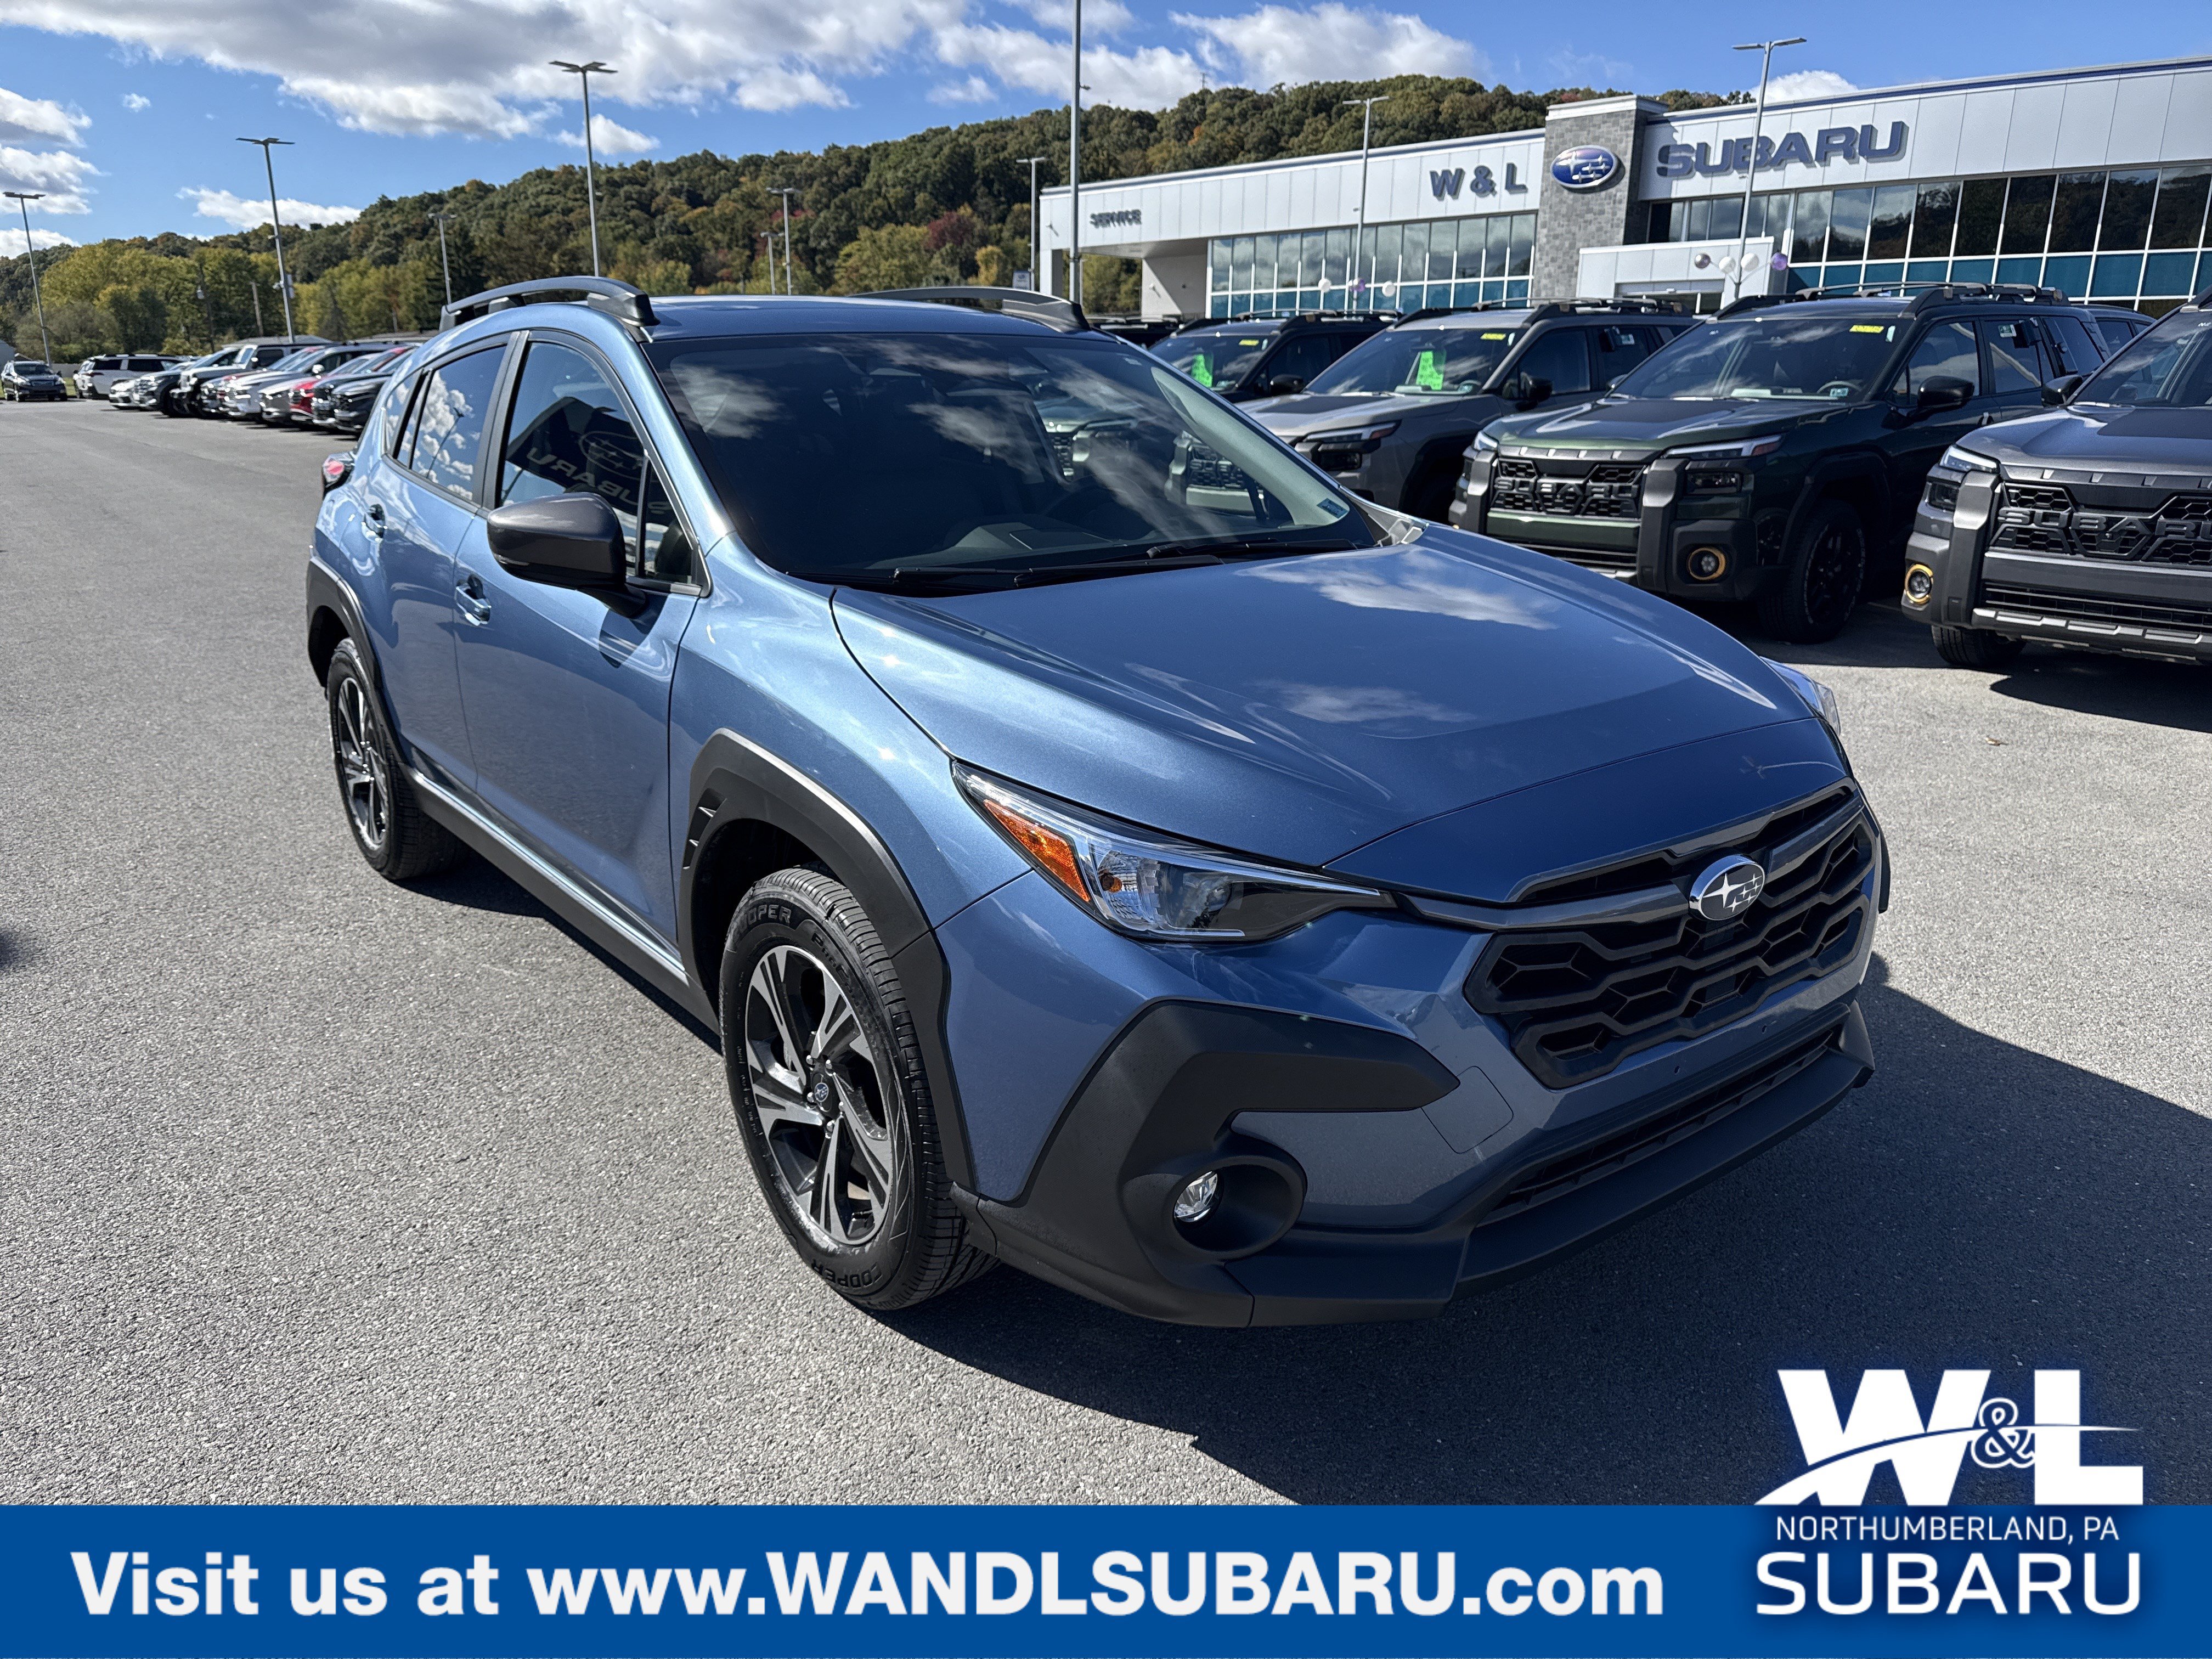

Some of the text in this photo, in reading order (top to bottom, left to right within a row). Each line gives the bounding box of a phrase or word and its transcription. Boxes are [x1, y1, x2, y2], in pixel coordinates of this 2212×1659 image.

[1657, 121, 1909, 179] SUBARU
[1429, 162, 1528, 201] W & L
[1090, 210, 1142, 229] SERVICE
[1494, 476, 1638, 498] SUBARU
[811, 1260, 883, 1288] COOPER
